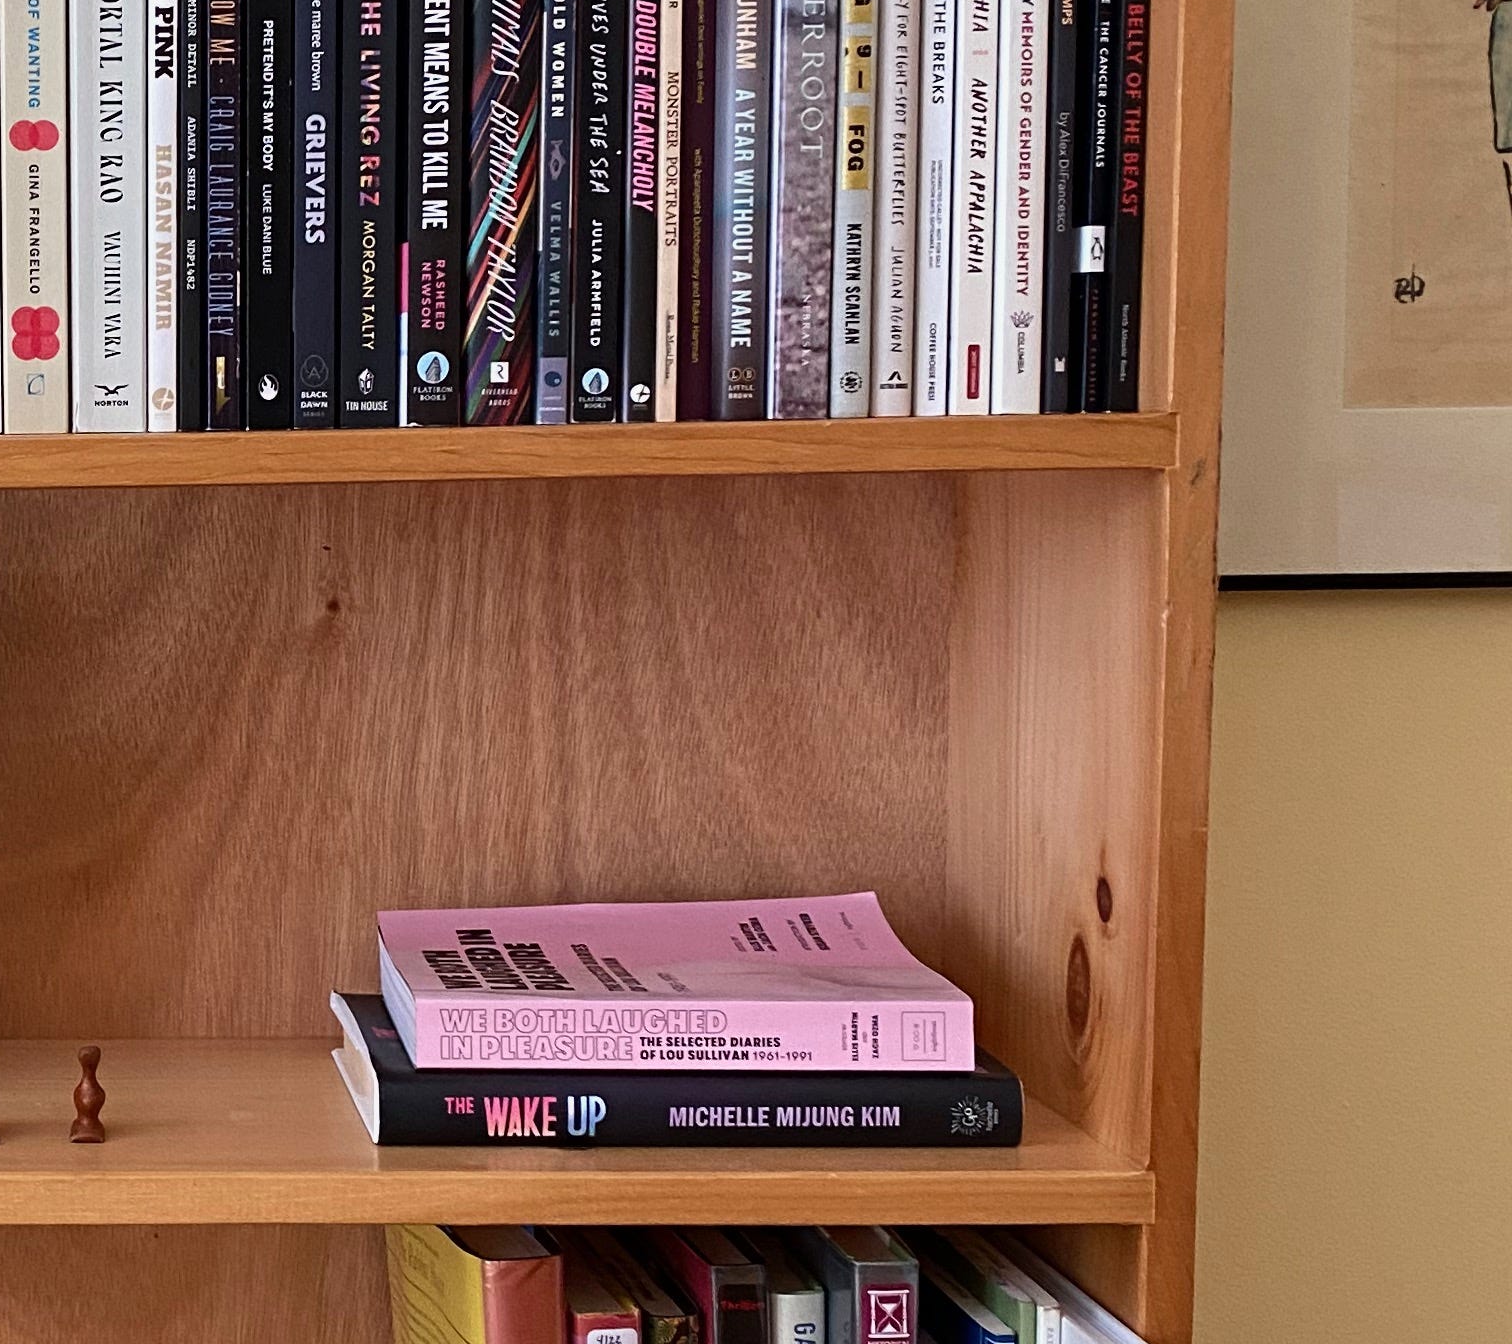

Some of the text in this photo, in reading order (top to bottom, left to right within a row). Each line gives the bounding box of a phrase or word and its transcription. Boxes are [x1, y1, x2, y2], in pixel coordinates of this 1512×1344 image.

[932, 1, 946, 104] THE BREAKS
[423, 41, 449, 118] MEANS
[631, 0, 657, 211] DOUBLE MELANCHOLY
[1122, 4, 1145, 218] BELLY OF THE BEAST
[423, 125, 446, 149] TO
[304, 114, 325, 245] GRIEVERS
[422, 154, 448, 197] KILL
[421, 202, 448, 230] ME
[845, 223, 860, 345] KATHRYN SCANLAN
[346, 400, 388, 411] TIN HOUSE
[640, 1038, 780, 1048] THE SELECTED DIARIES
[640, 1049, 812, 1061] OF LOU SULLIVAN 1961-1991
[445, 1096, 607, 1136] THE WAKE UP
[669, 1106, 900, 1127] MICHELLE MIJUNG KIM
